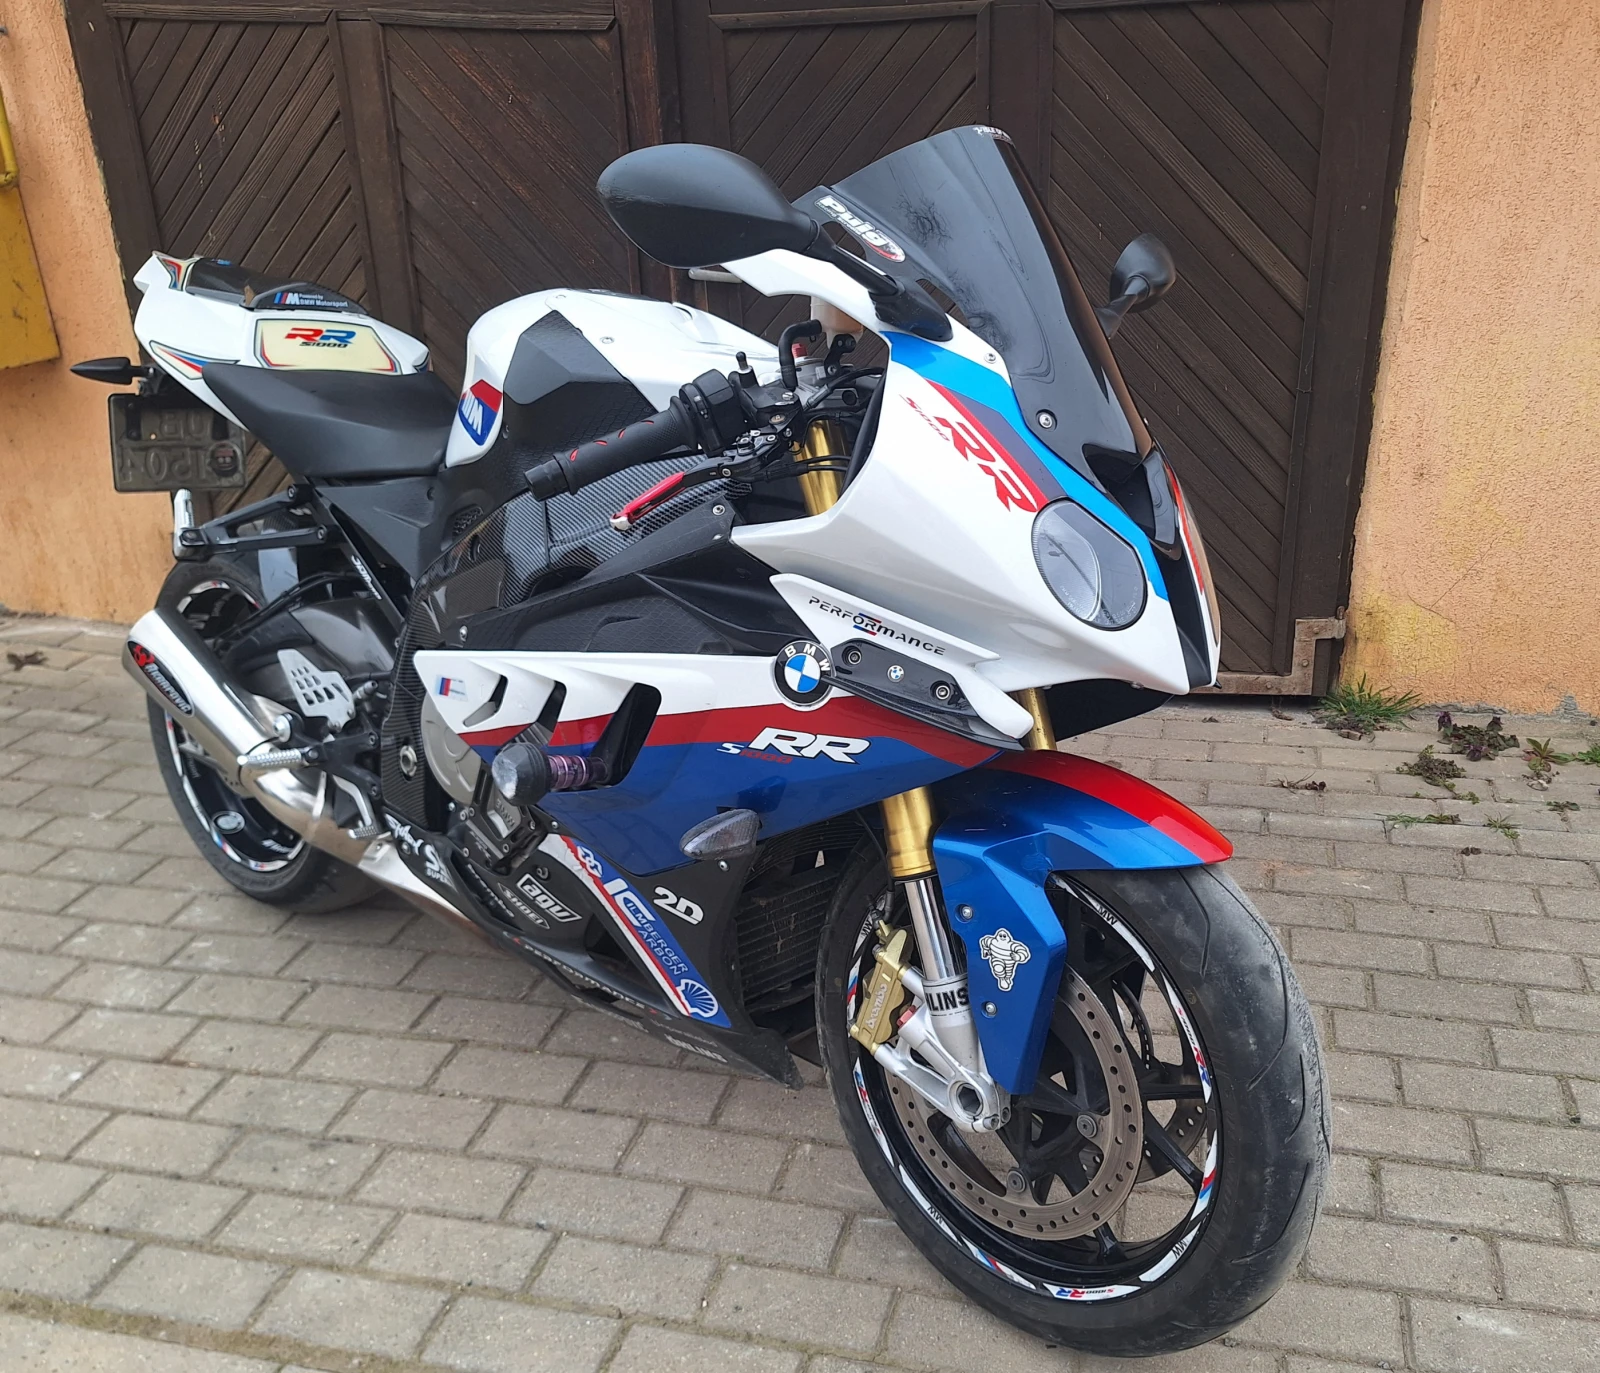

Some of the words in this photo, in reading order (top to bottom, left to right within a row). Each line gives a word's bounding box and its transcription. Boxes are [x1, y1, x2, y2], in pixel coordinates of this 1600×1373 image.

[819, 195, 889, 247] Puig
[316, 299, 349, 308] Motorsport
[285, 327, 356, 344] RR
[933, 416, 1038, 513] RR
[808, 596, 946, 656] PERFORMANCE
[747, 726, 870, 764] RR
[504, 889, 544, 924] SHOEI
[522, 883, 572, 918] agu
[653, 886, 704, 925] 2D
[626, 902, 689, 973] ILMBERGER
[866, 982, 888, 1030] brembo
